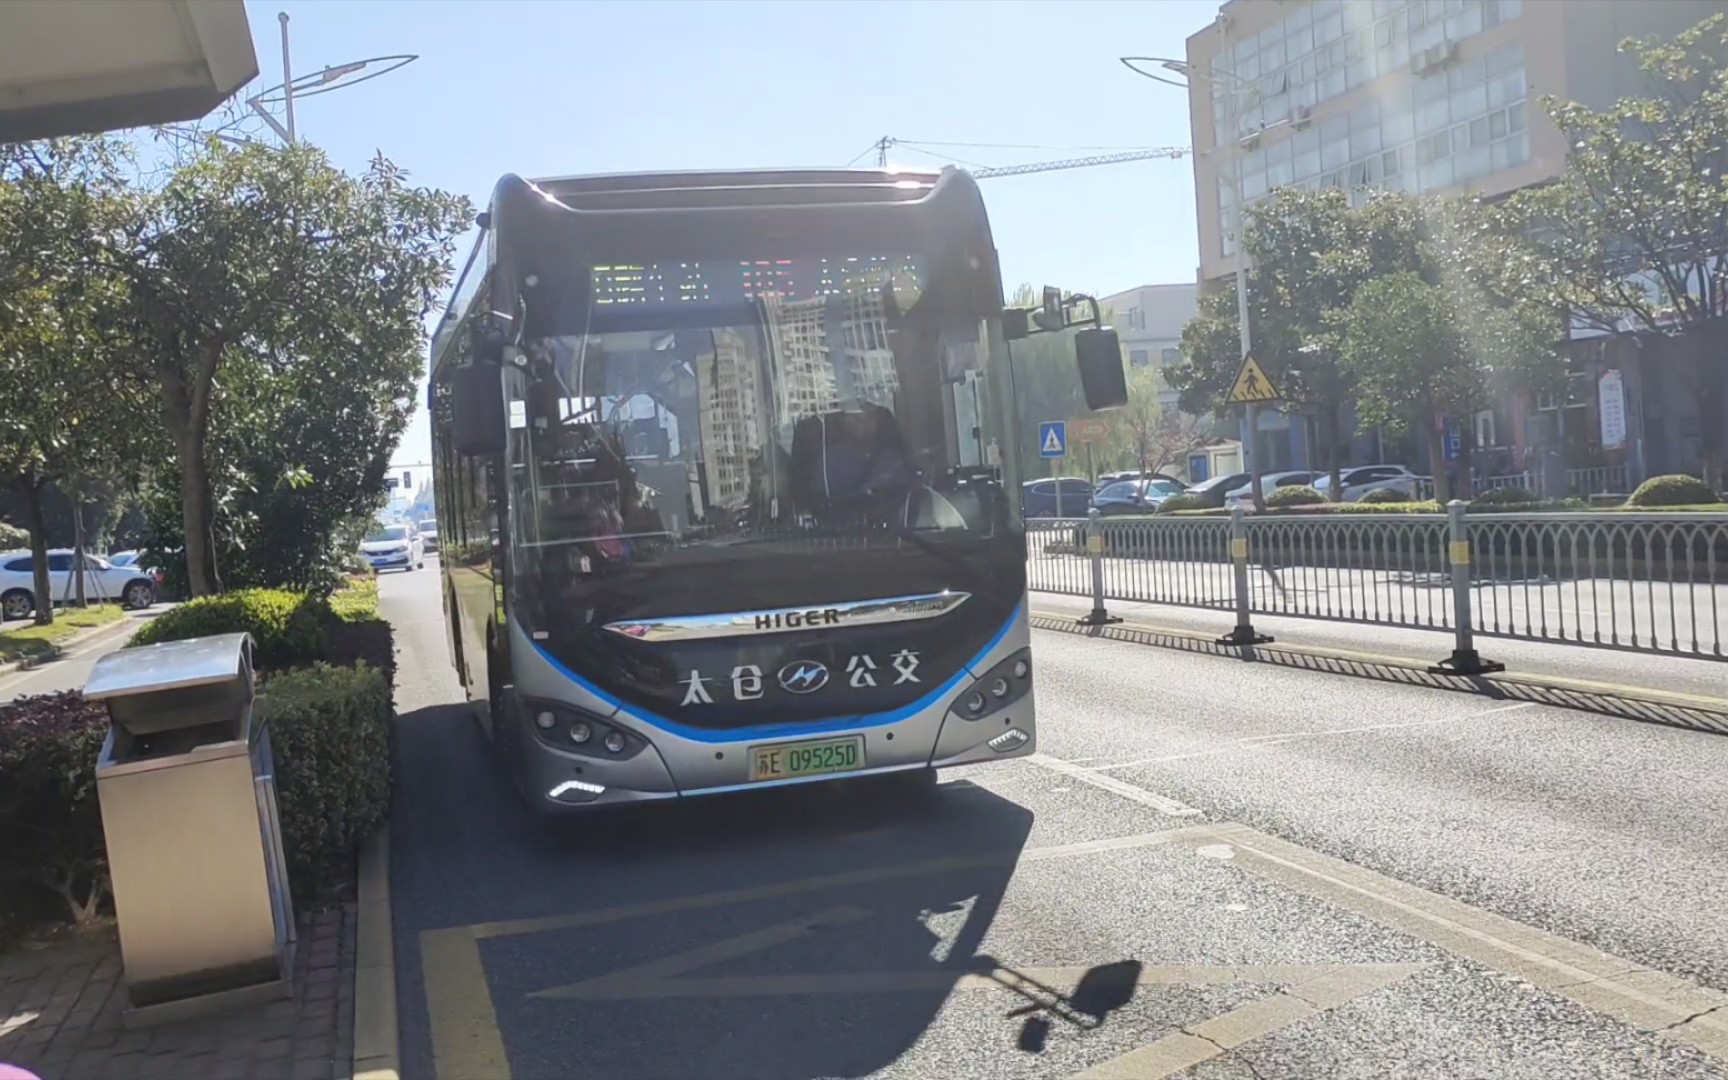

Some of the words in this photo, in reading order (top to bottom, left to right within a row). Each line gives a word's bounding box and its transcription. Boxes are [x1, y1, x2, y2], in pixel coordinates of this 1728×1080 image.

[755, 608, 840, 630] HIGER
[678, 665, 764, 707] 太仓
[846, 649, 922, 688] 公交
